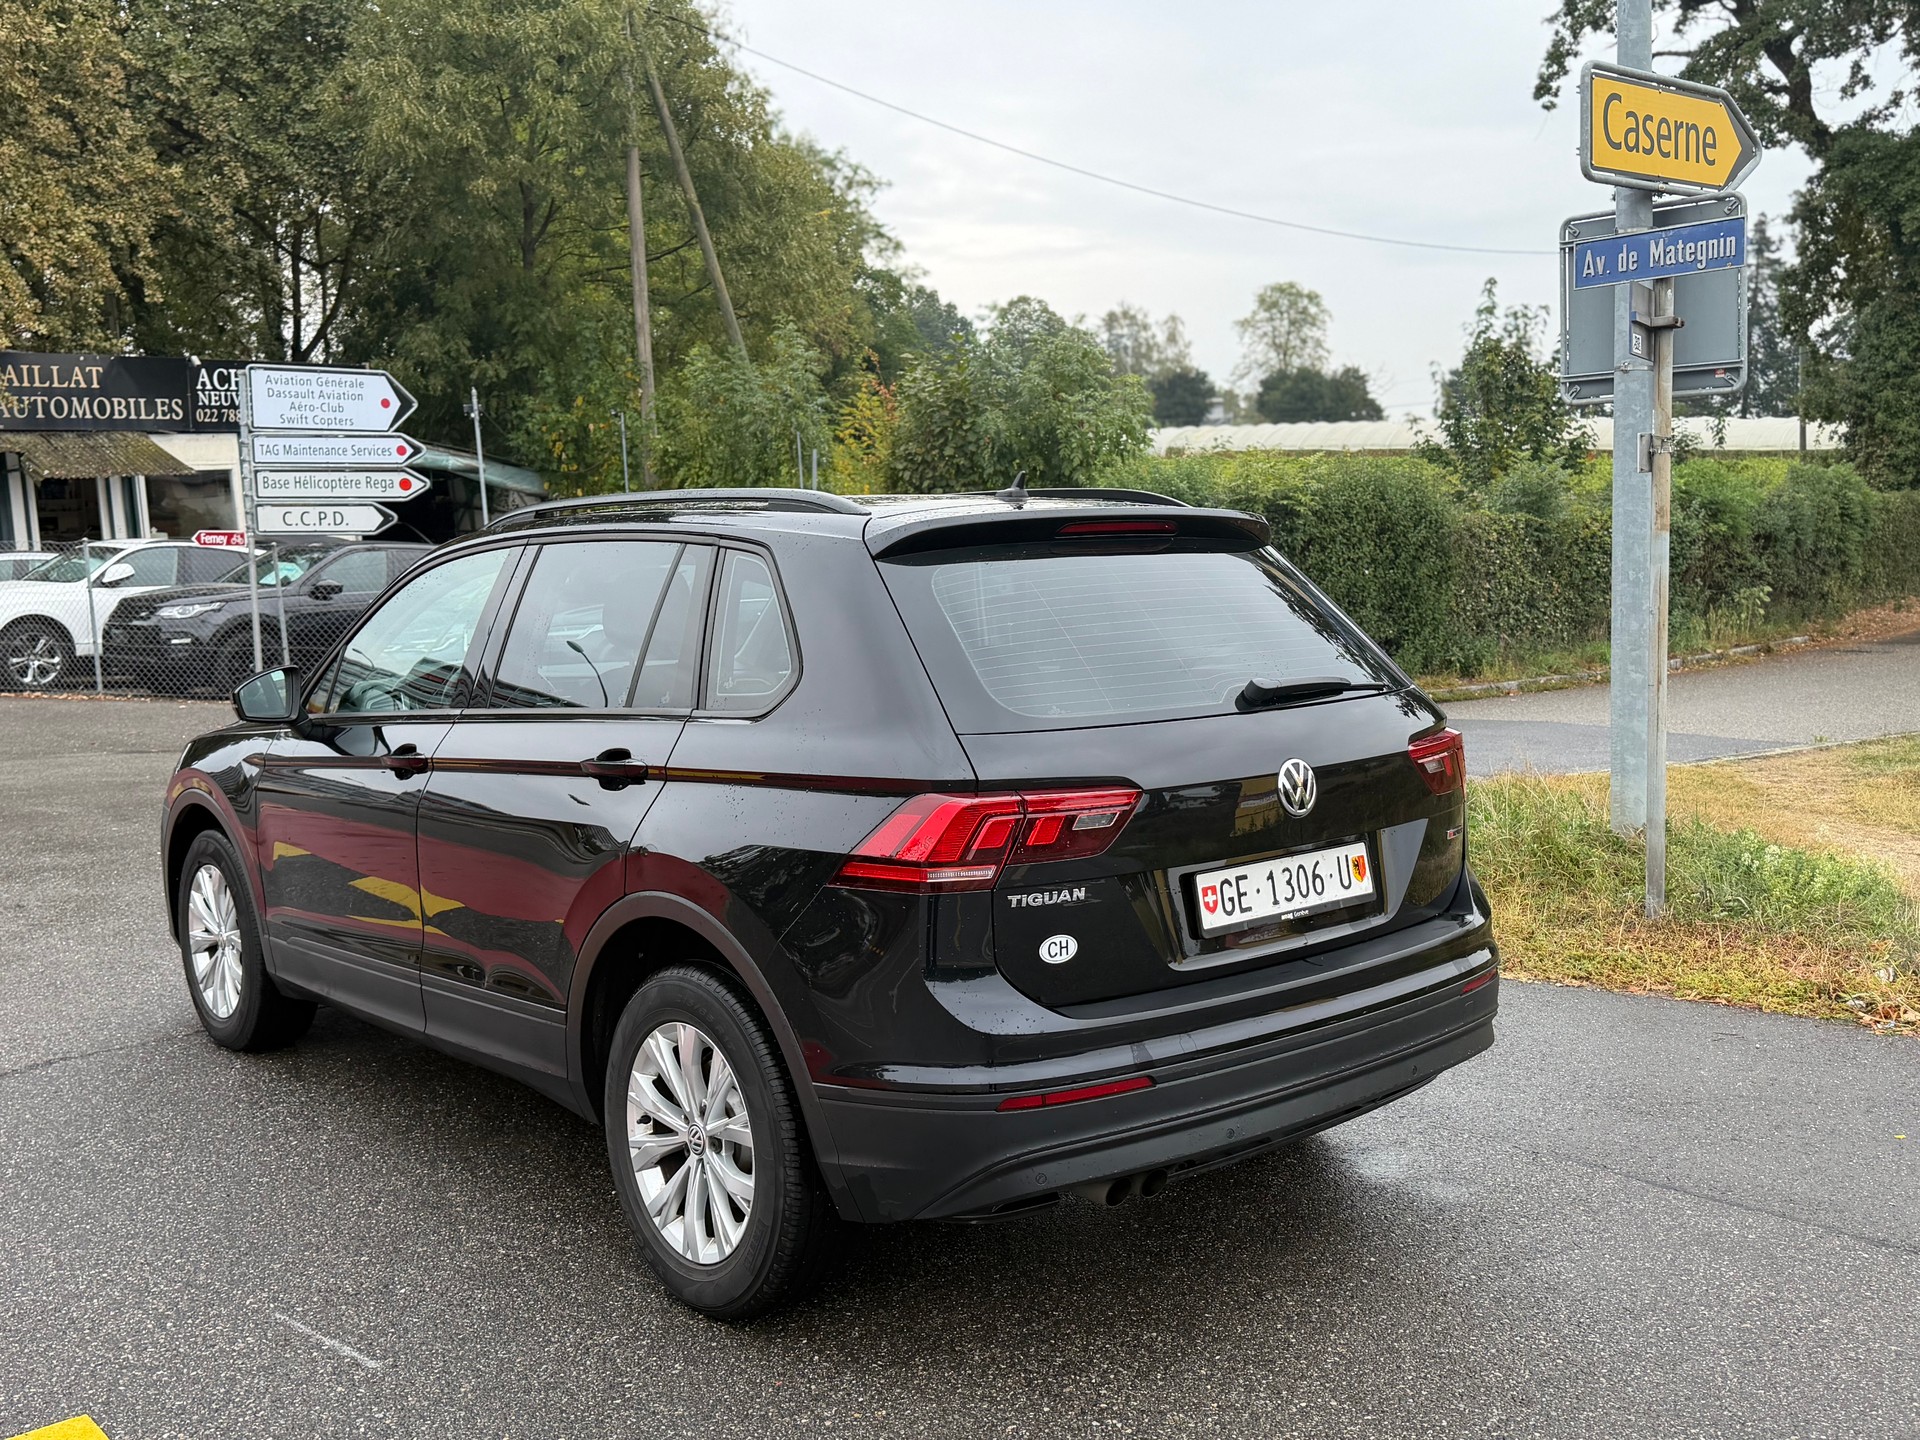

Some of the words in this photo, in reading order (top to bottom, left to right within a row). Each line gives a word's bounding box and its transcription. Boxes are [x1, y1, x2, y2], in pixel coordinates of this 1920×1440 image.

[1602, 92, 1718, 167] Caserne
[1582, 249, 1611, 278] Av.
[1617, 244, 1638, 273] de
[1649, 232, 1737, 269] Mategnin
[265, 374, 312, 387] Aviation
[316, 376, 365, 389] Générale
[267, 387, 315, 400] Dassault
[318, 390, 364, 401] Aviation
[289, 401, 345, 414] Aéro-Club
[196, 408, 219, 423] 022
[279, 413, 308, 425] Swift
[312, 415, 355, 427] Copters
[259, 444, 280, 456] TAG
[283, 443, 347, 456] Maintenance
[351, 444, 393, 457] Services
[262, 476, 290, 489] Base
[293, 475, 361, 492] Hélicoptère
[365, 476, 394, 492] Rega
[282, 511, 349, 526] C.C.P.D.
[200, 533, 228, 546] Ferney
[1007, 887, 1086, 908] TIGUAN
[1047, 939, 1069, 958] CH
